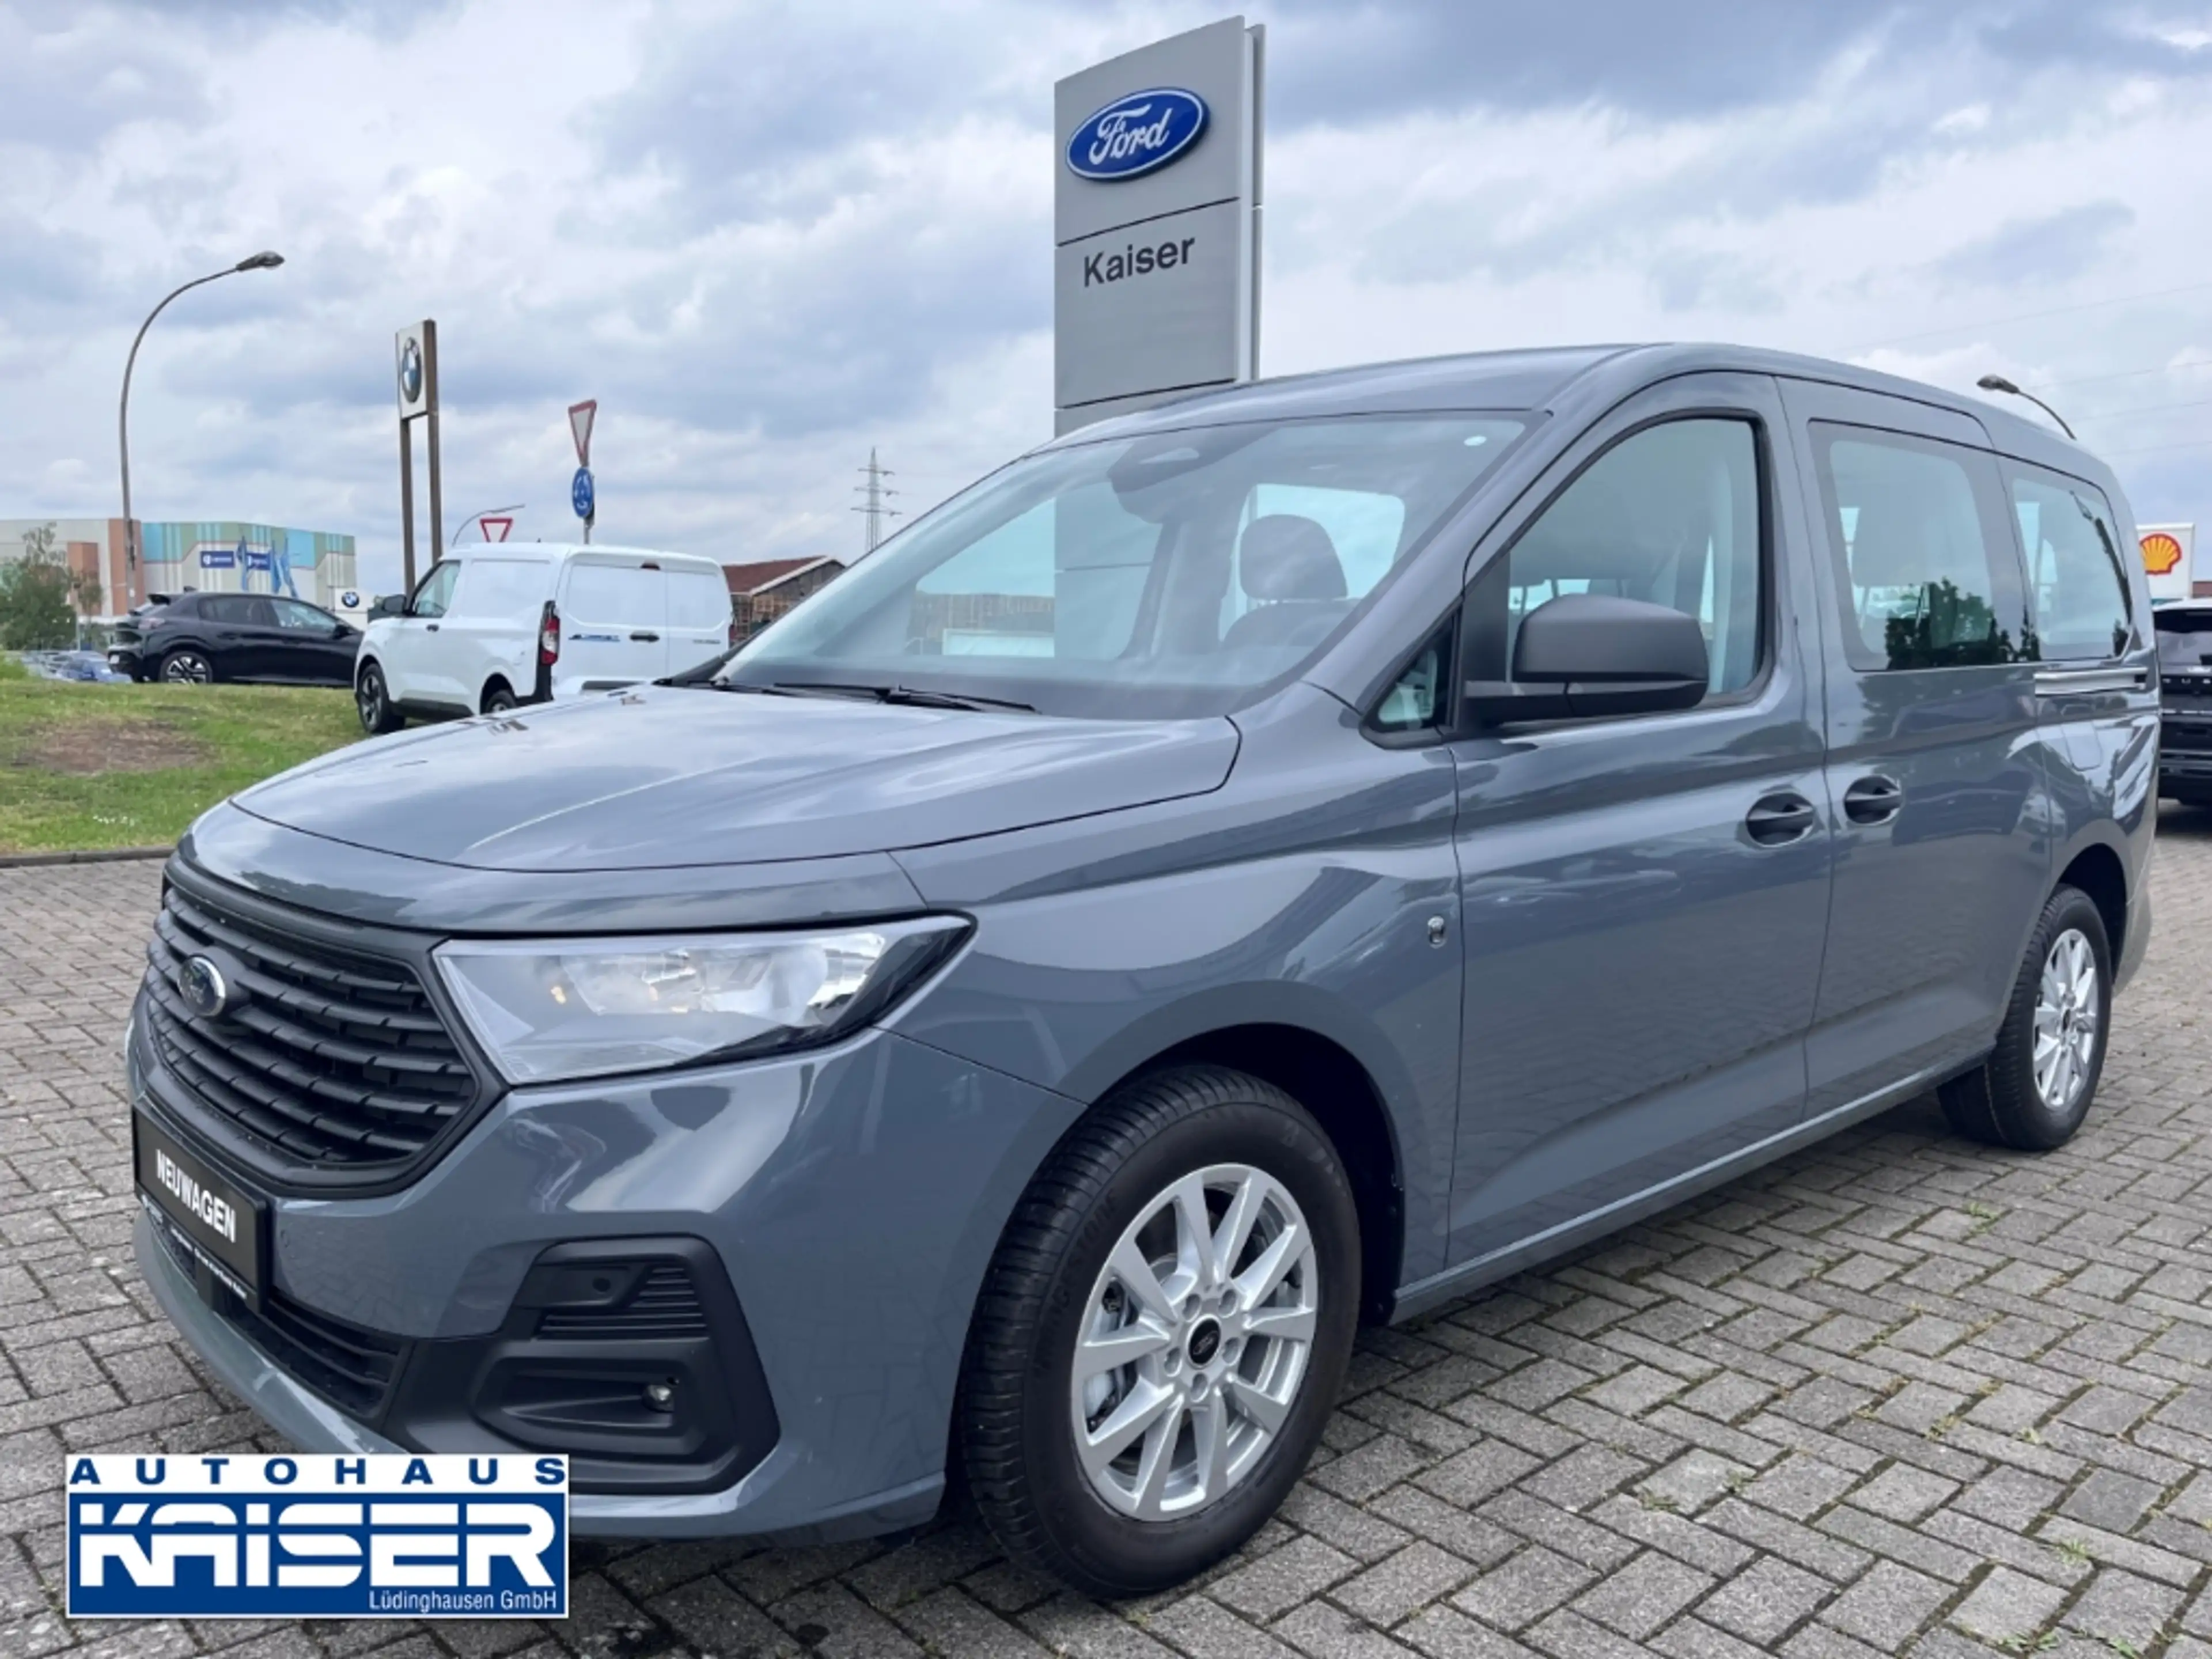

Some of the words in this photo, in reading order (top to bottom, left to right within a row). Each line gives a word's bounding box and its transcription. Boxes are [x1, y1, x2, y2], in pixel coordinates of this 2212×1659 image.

[1088, 103, 1173, 165] Ford
[1084, 237, 1195, 287] Kaiser
[156, 1149, 236, 1243] NEUWAGEN
